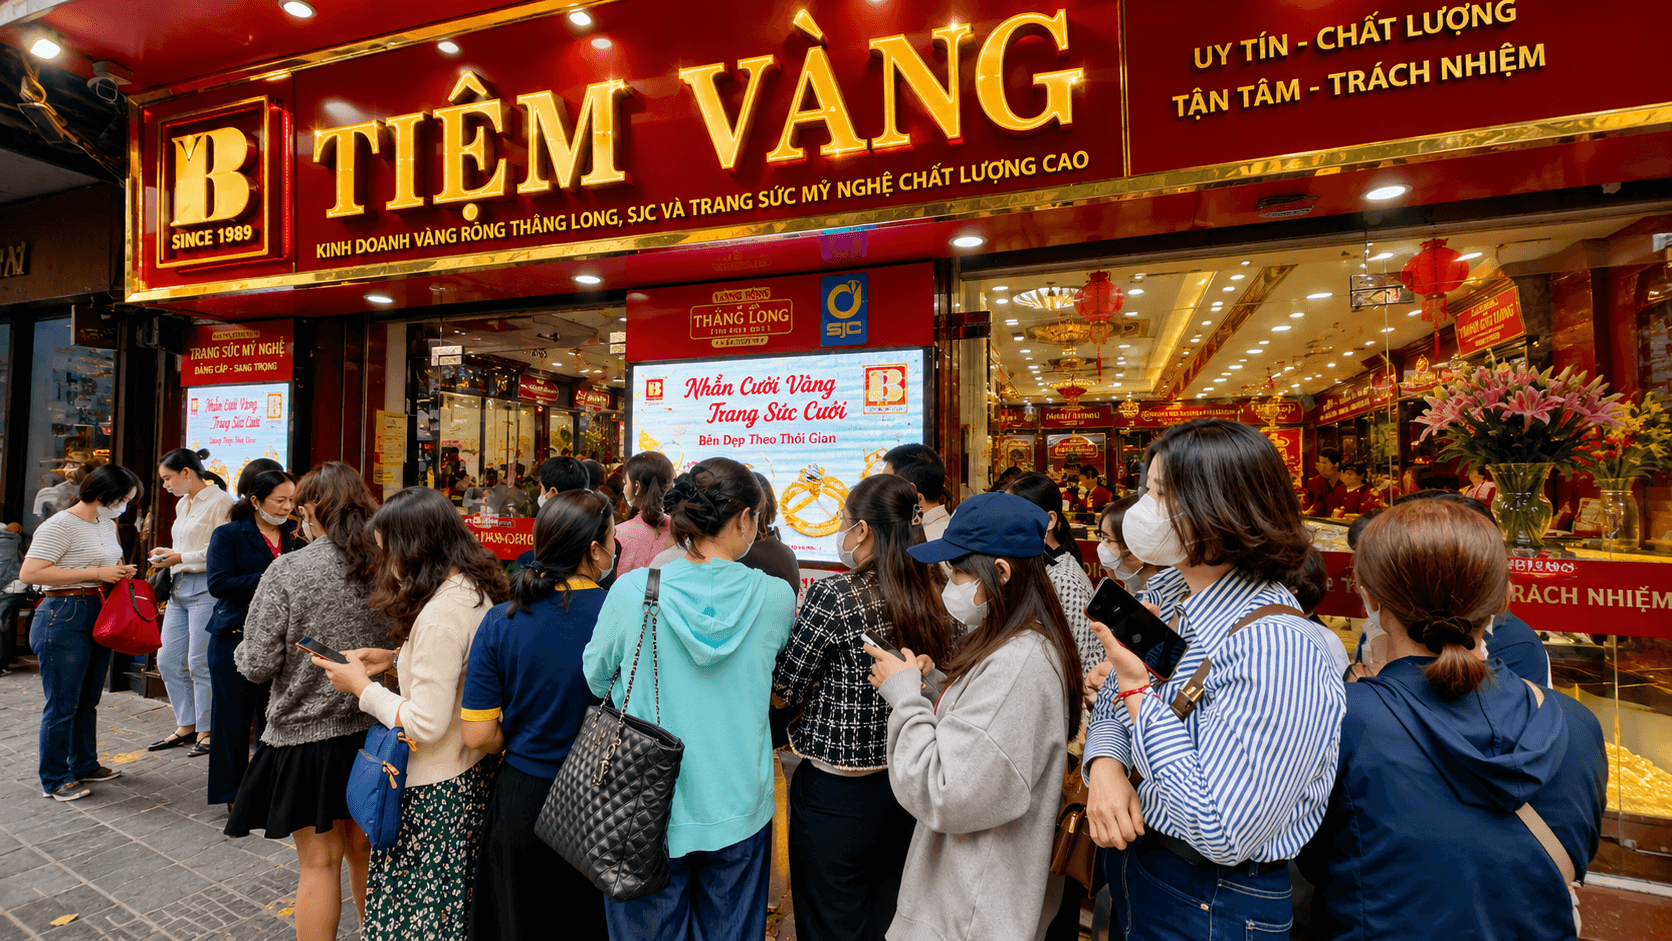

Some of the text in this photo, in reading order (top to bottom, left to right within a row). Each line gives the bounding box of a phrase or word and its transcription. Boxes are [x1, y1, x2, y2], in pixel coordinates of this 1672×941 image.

[1194, 42, 1233, 69] UY
[1240, 31, 1288, 62] TÍN
[1316, 10, 1397, 50] CHẤT
[1406, 0, 1517, 37] LƯỢNG
[678, 9, 1084, 170] VÀNG
[1172, 87, 1229, 120] TẬN
[1237, 78, 1301, 109] TÂM
[1327, 61, 1430, 95] TRÁCH
[1441, 42, 1546, 81] NHIỆM
[312, 71, 627, 221] TIỆM
[316, 240, 352, 259] KINH
[355, 233, 411, 255] DOANH
[413, 227, 457, 247] VÀNG
[571, 208, 623, 230] LONG,
[627, 204, 657, 223] SJC
[661, 197, 686, 219] VÀ
[689, 193, 753, 216] TRANG
[758, 185, 797, 209] SỨC
[837, 171, 894, 200] NGHỆ
[898, 163, 955, 191] CHẤT
[960, 158, 1037, 185] LƯỢNG
[1042, 150, 1090, 173] CAO
[171, 224, 252, 250] SINCE 1989
[190, 346, 220, 361] TRANG
[826, 320, 862, 339] SJC
[706, 401, 760, 429] Trang
[748, 434, 777, 445] Theo
[808, 432, 837, 444] Gian
